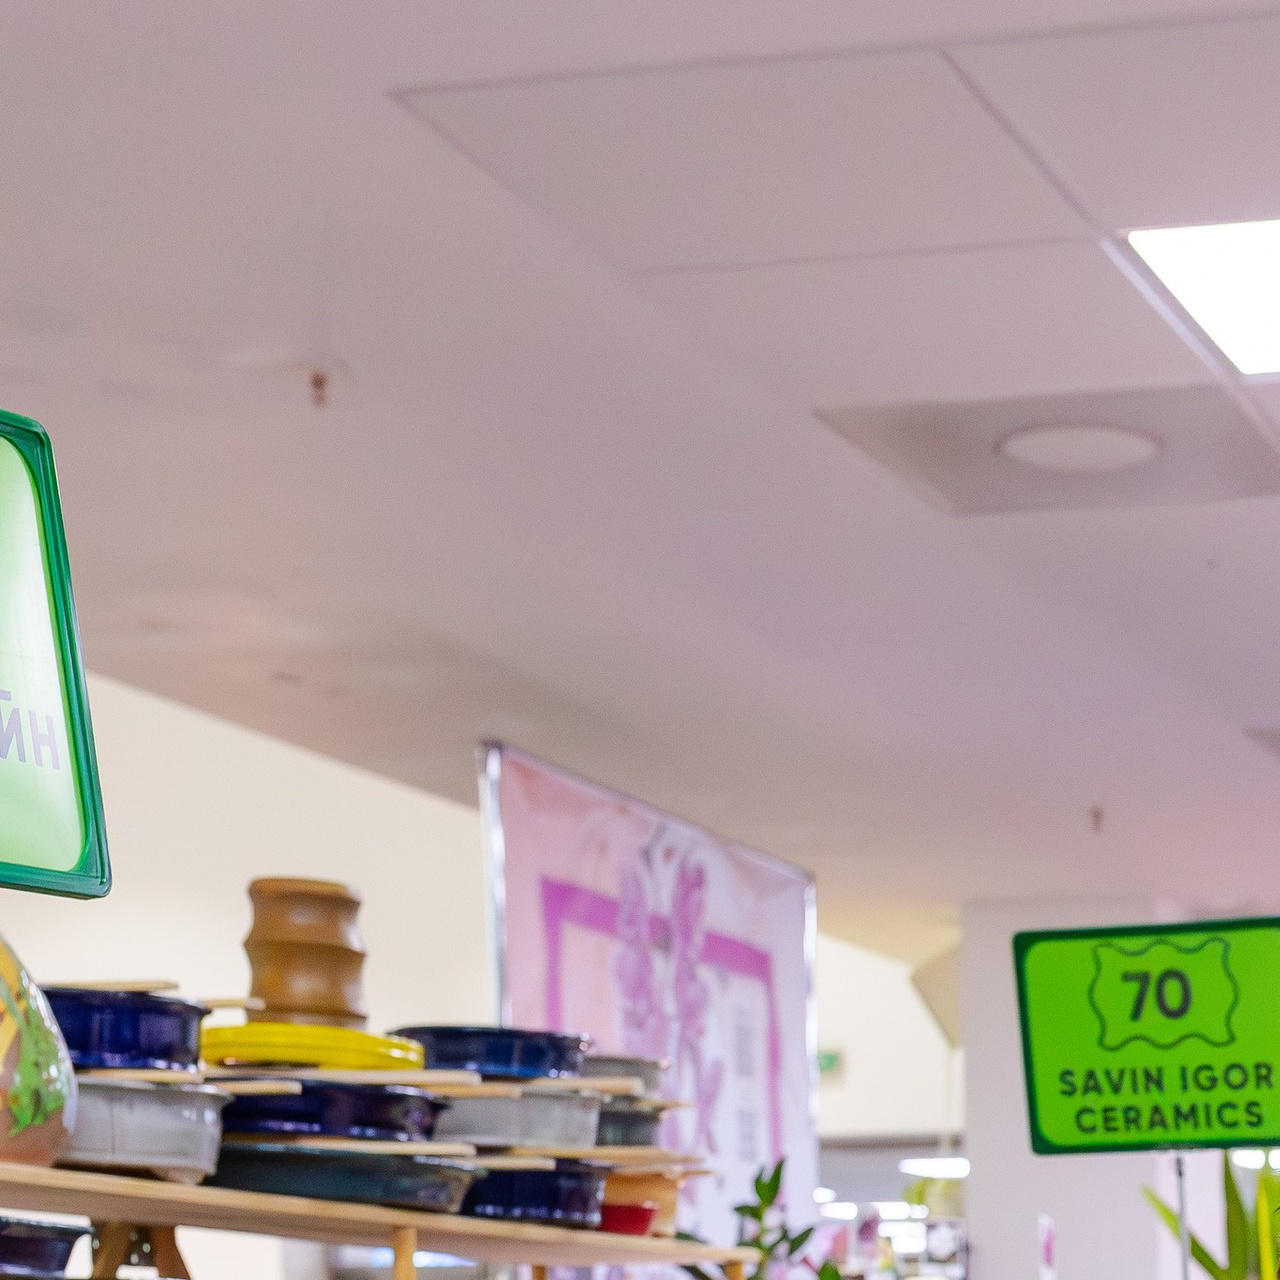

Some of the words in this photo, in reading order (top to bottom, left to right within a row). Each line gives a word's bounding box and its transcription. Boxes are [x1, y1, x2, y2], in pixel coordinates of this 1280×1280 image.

[1121, 967, 1192, 1022] 70
[1058, 1065, 1165, 1097] SAVIN
[1180, 1061, 1275, 1092] IGOR
[1074, 1100, 1264, 1134] CERAMICS
